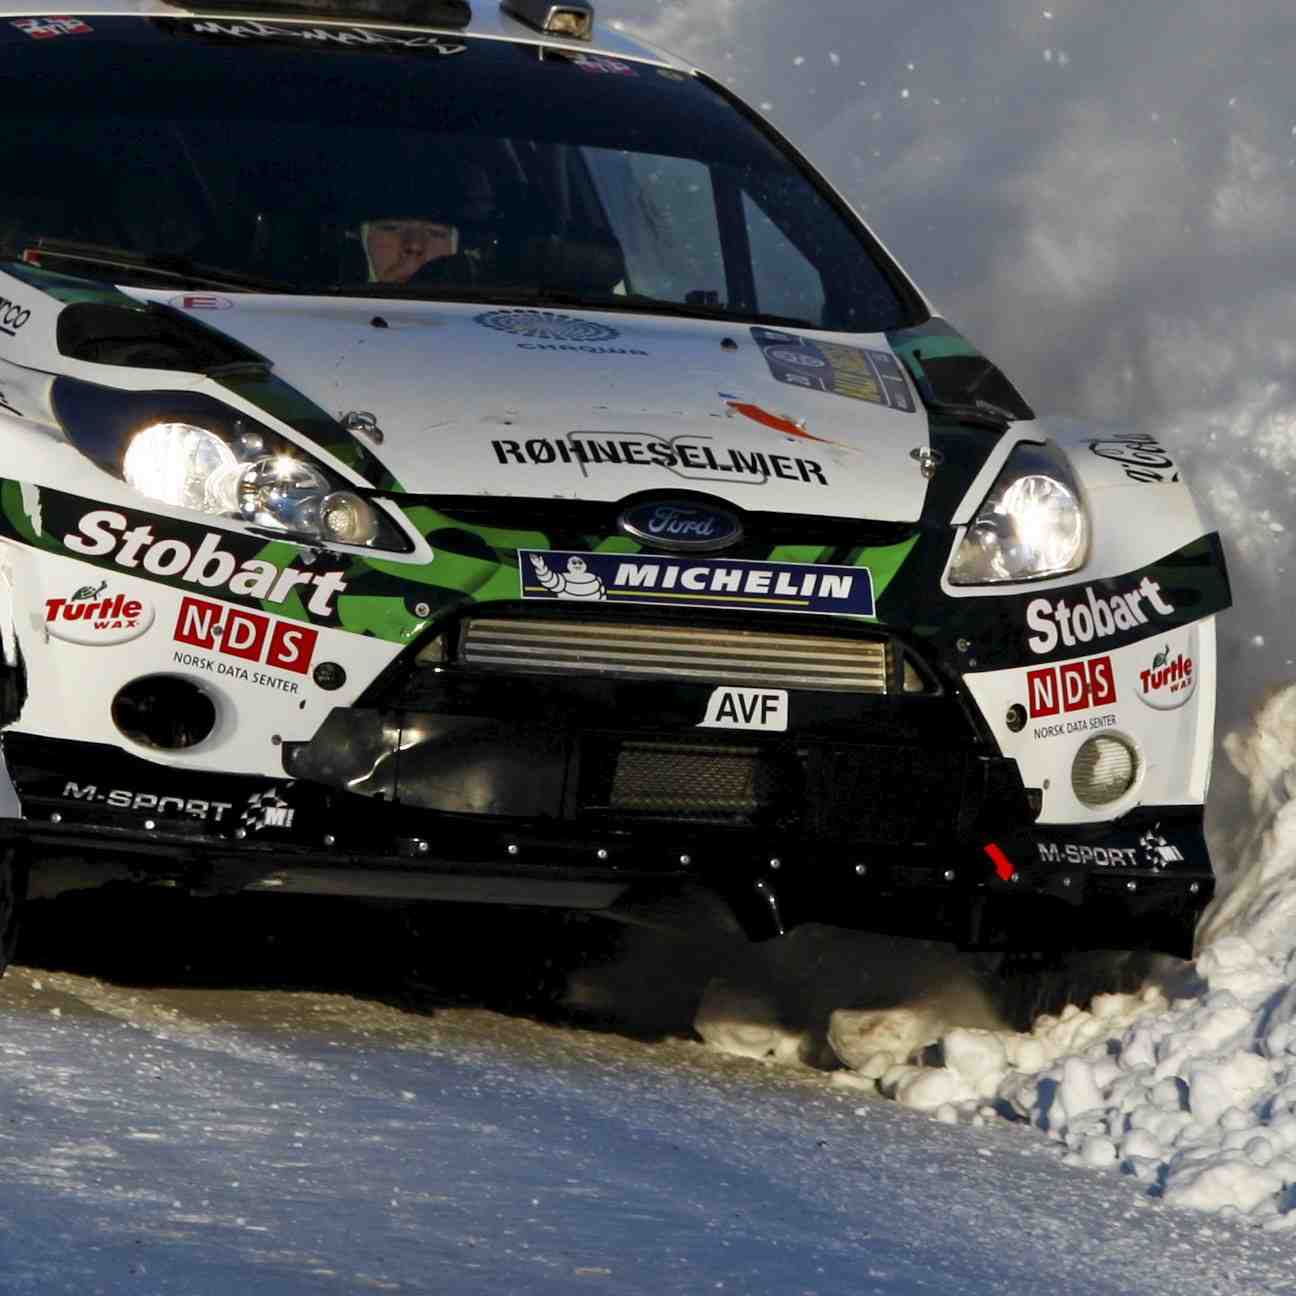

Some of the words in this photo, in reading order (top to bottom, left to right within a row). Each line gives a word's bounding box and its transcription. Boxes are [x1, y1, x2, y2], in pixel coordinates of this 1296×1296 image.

[491, 437, 830, 486] RØHNESELMER
[648, 506, 715, 537] Ford
[62, 509, 349, 617] Stobart
[613, 562, 854, 600] MICHELIN
[45, 594, 143, 622] Turtle
[93, 620, 138, 631] WAX
[1025, 576, 1176, 655] Stobart
[173, 651, 214, 671] NORSK
[216, 662, 249, 681] DATA
[252, 672, 299, 695] SENTER
[1140, 654, 1193, 694] Turtle
[715, 692, 780, 725] AVF
[1033, 724, 1065, 739] NORSK
[1066, 719, 1088, 734] DATA
[1089, 714, 1117, 730] SENTER
[62, 781, 233, 822] M-SPORT
[1036, 842, 1137, 867] M-SPORT
